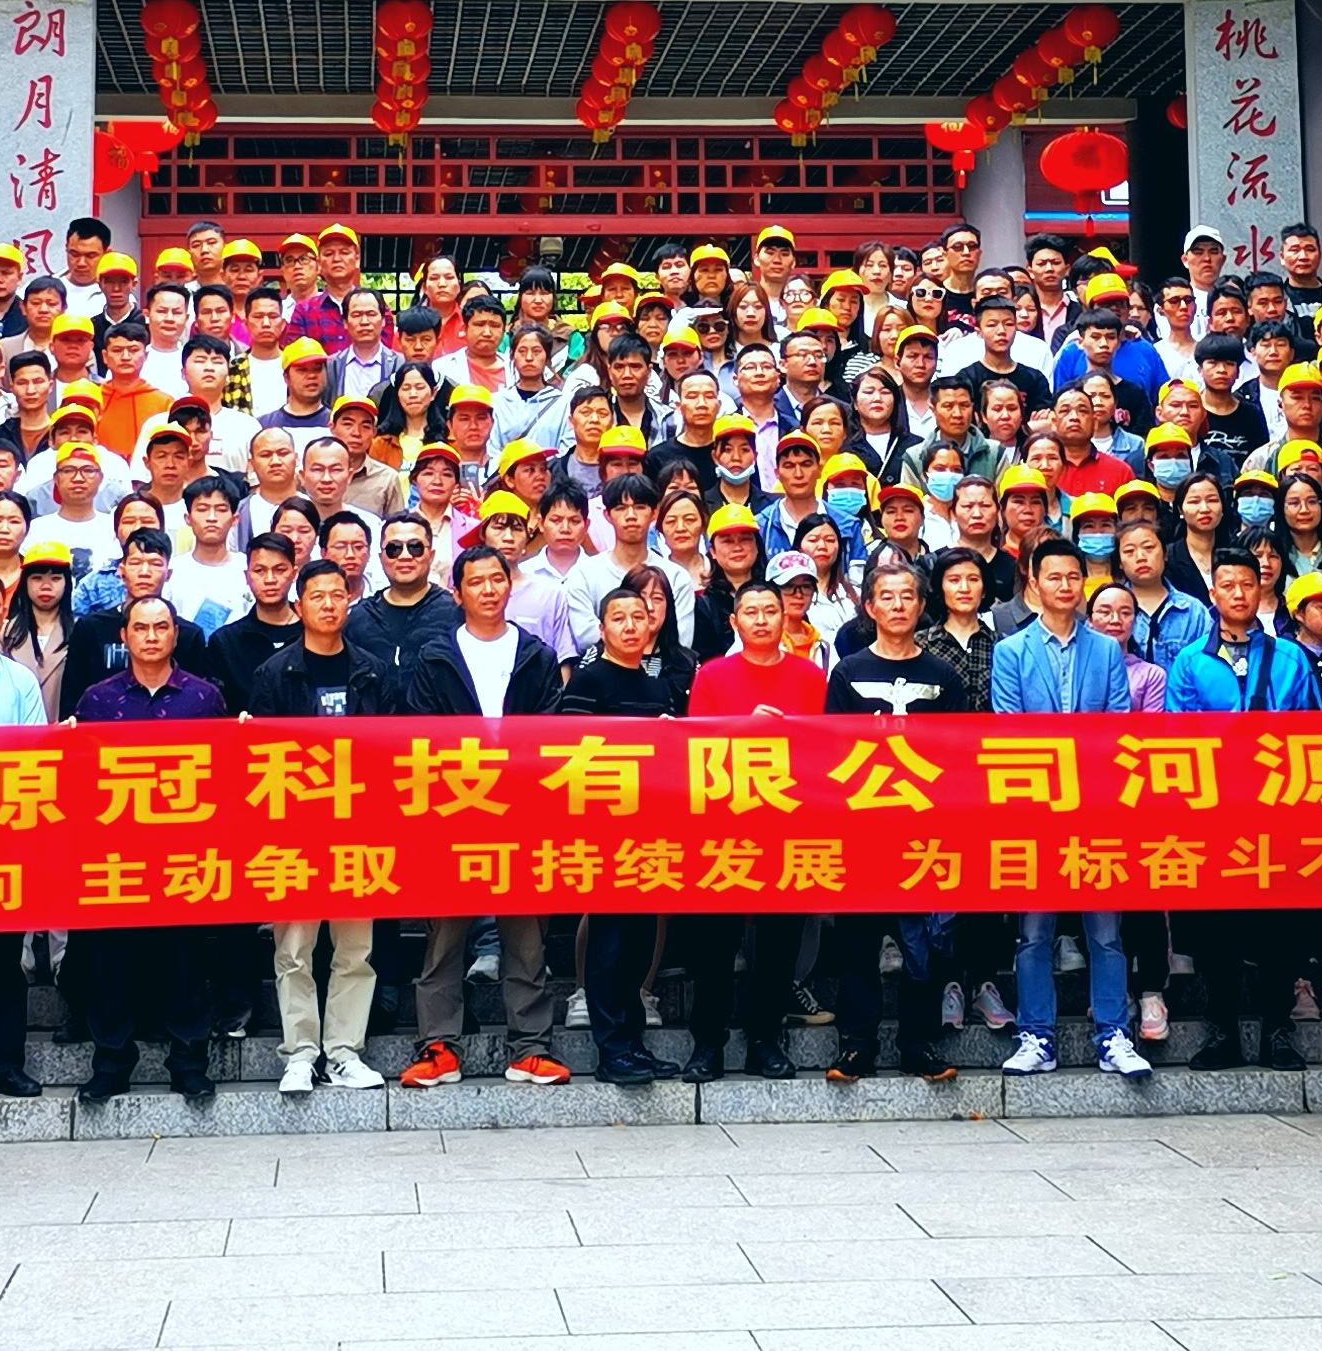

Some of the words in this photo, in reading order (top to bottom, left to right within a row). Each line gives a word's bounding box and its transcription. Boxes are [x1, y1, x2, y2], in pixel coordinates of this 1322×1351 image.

[1214, 8, 1281, 274] 桃花流水
[77, 843, 402, 906] 主动争取
[450, 838, 847, 895] 可持续发展
